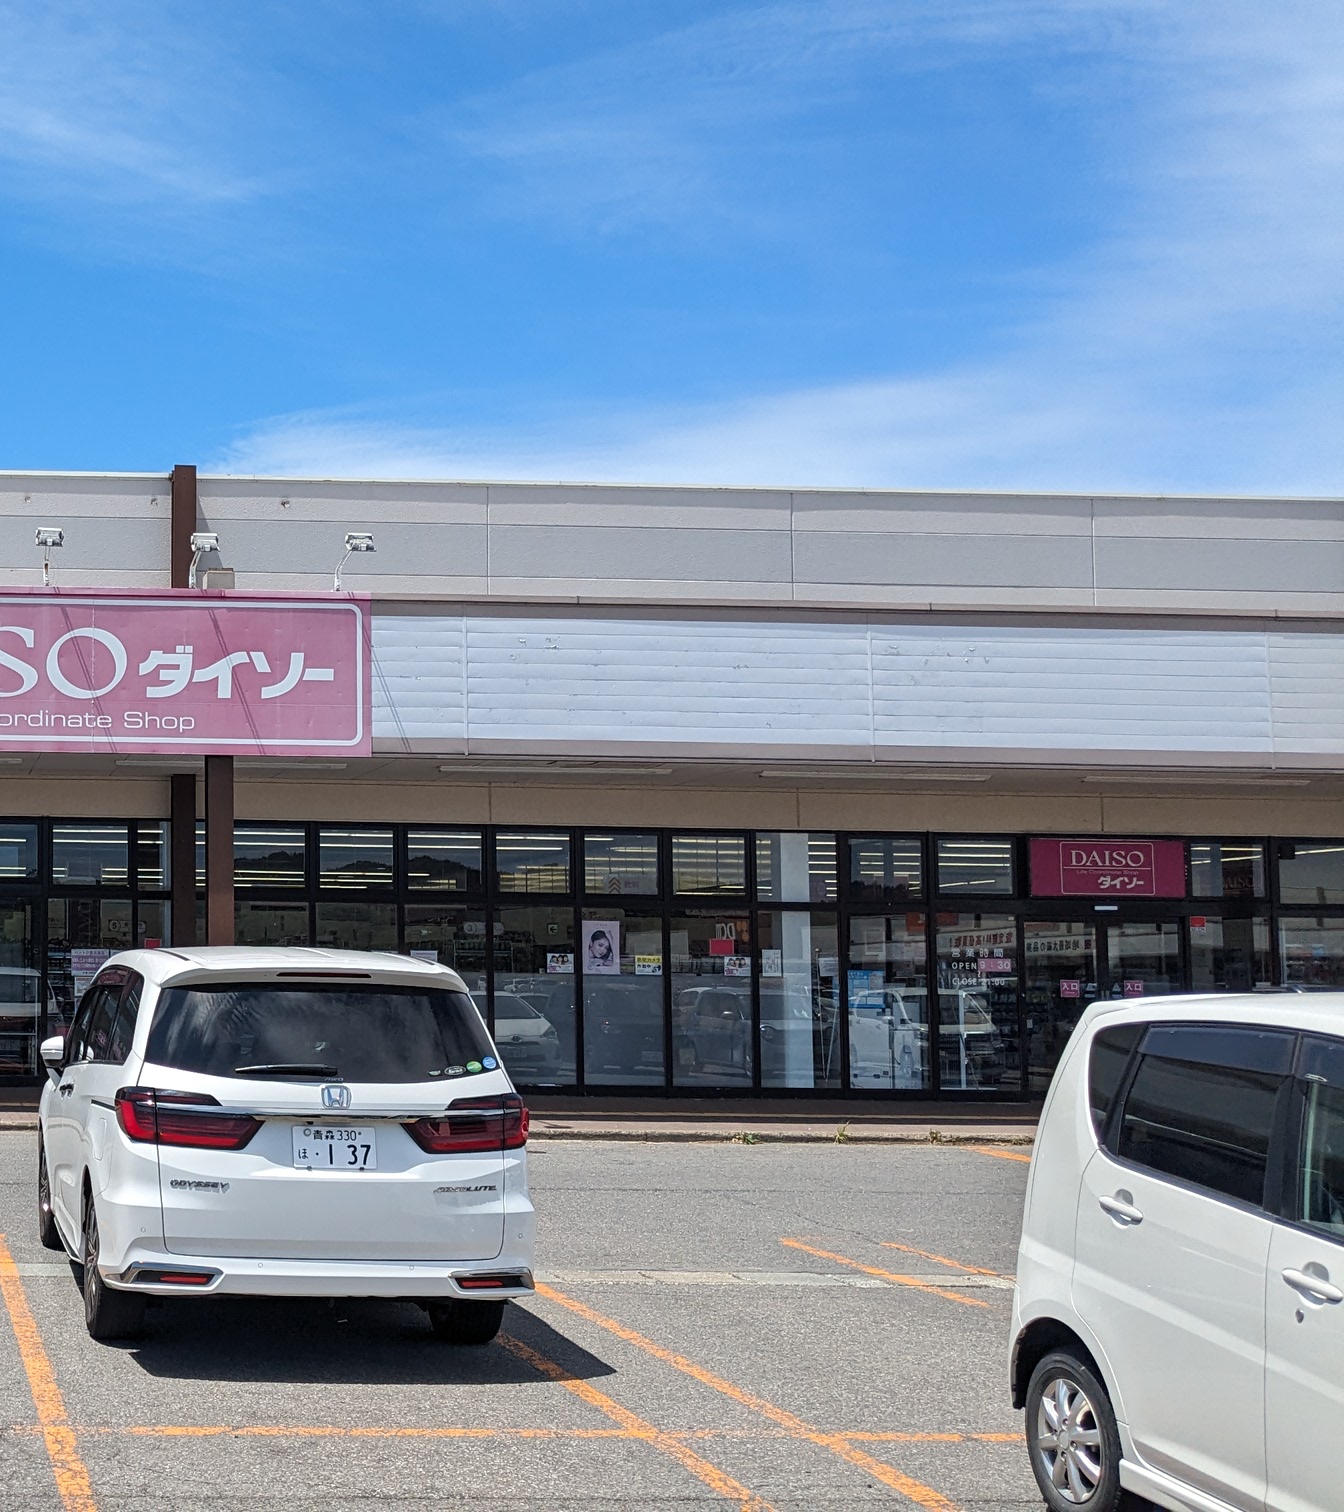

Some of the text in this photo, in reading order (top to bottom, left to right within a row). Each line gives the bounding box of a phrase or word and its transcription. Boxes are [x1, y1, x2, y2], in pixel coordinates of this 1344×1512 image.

[139, 645, 335, 699] ダイソー
[123, 710, 196, 732] Shop
[1070, 850, 1144, 867] DAISO
[1097, 876, 1144, 889] ダイソー
[951, 962, 977, 970] OPEN
[952, 978, 977, 986] CLOSE
[1062, 982, 1079, 991] 入口
[1125, 983, 1142, 992] 入口
